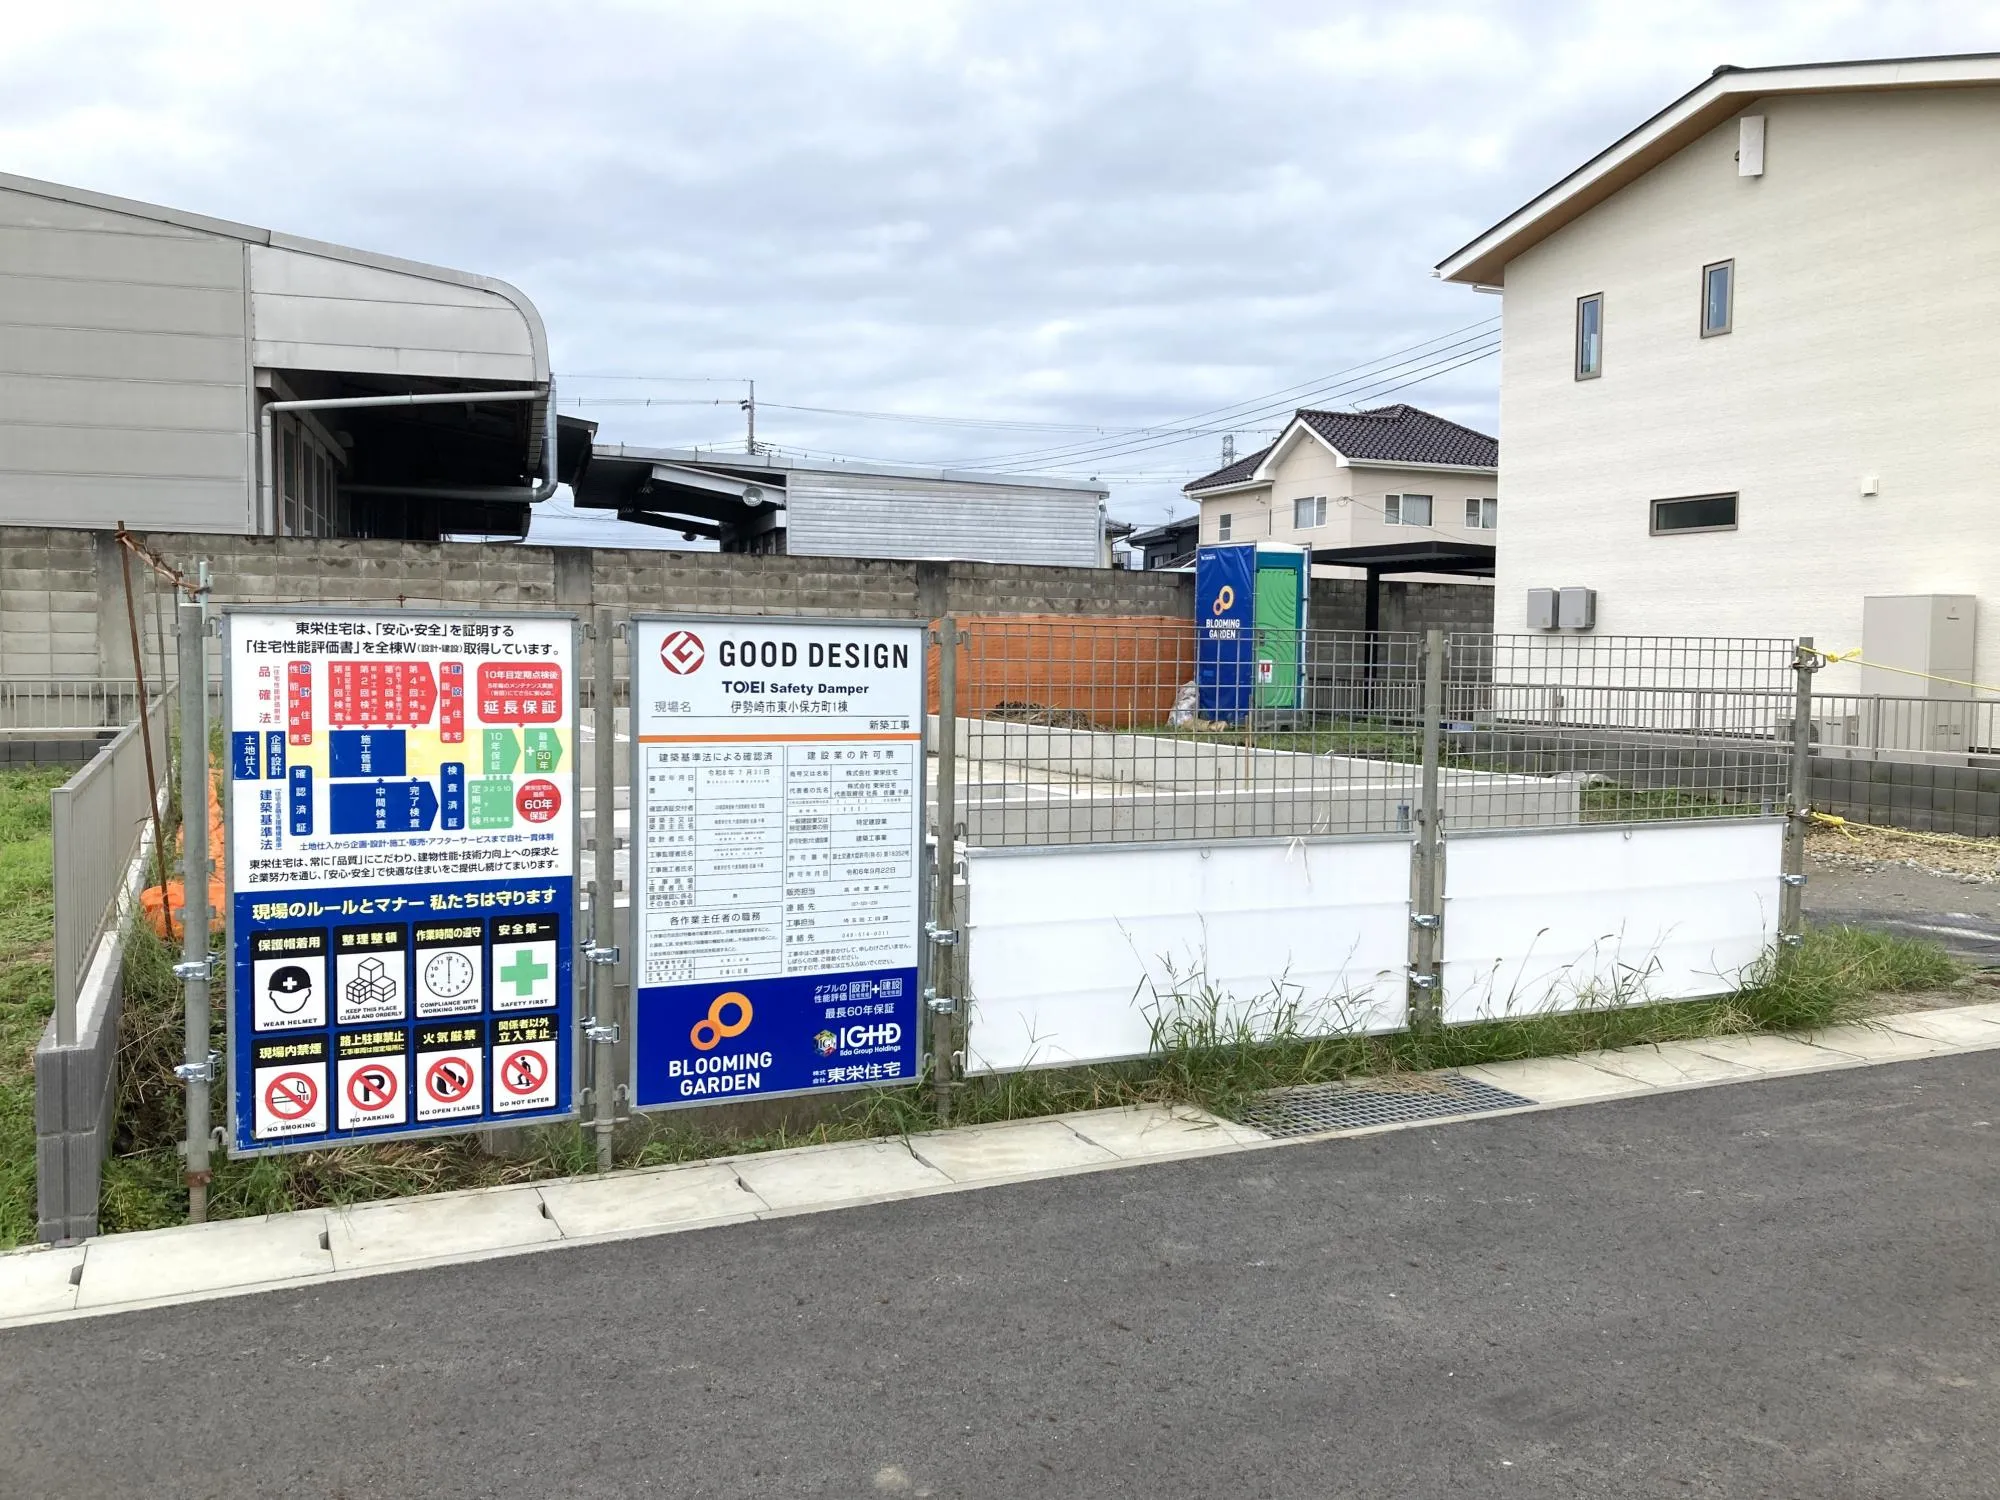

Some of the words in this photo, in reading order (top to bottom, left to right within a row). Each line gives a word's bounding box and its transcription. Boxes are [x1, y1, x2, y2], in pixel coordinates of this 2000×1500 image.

[296, 622, 514, 637] 東栄住宅は、「安心・安全」を証明する
[1206, 619, 1240, 628] BLOOMING
[719, 640, 797, 667] GOOD
[808, 642, 908, 668] DESIGN
[484, 670, 560, 680] 10年目定期点検後
[770, 683, 813, 695] Safety
[818, 683, 869, 695] Damper
[483, 700, 557, 714] 延長保証
[654, 701, 692, 713] 現場名
[730, 700, 849, 714] 伊勢崎市東小保方町1棟
[869, 720, 910, 730] 新築工事
[244, 735, 256, 776] 土地仕入
[270, 735, 282, 776] 企画・設計
[361, 735, 372, 773] 施工管理
[658, 752, 773, 762] 建築基準法による確認済
[295, 769, 307, 833] 確認済証
[447, 766, 458, 828] 検査済証
[524, 799, 553, 810] 60年
[375, 787, 386, 829] 中間検査
[409, 786, 420, 828] 完了検査
[260, 789, 272, 850] 建築基準法
[529, 811, 548, 820] 保証
[252, 897, 425, 920] 現場のルールとマナー
[430, 888, 556, 910] 私たちは守ります
[670, 912, 760, 926] 各作業主任者の職務
[416, 927, 482, 942] 作業時間の遵守
[498, 923, 550, 936] 安全第一
[258, 936, 321, 952] 保護帽着用
[341, 932, 398, 947] 整理整頓
[815, 983, 848, 994] ダブルの
[420, 1000, 461, 1008] COMPLIANCE
[814, 992, 848, 1003] 性能評価
[423, 1006, 453, 1014] WORKING
[825, 1003, 895, 1019] 最長60年保証
[287, 1018, 318, 1026] HELMET
[498, 1017, 549, 1030] 関係者以外
[340, 1031, 404, 1046] 路上駐車禁止
[423, 1029, 476, 1044] 火気厳禁
[499, 1028, 549, 1042] 立入禁止
[840, 1023, 901, 1048] IGHD
[259, 1043, 322, 1059] 現場内禁煙
[853, 1047, 873, 1056] Group
[874, 1045, 901, 1054] Holdings
[669, 1052, 773, 1078] BLOOMING
[827, 1062, 901, 1083] 東栄住宅
[680, 1072, 761, 1096] GARDEN
[453, 1104, 480, 1112] FLAMES
[280, 1122, 316, 1131] SMOKING
